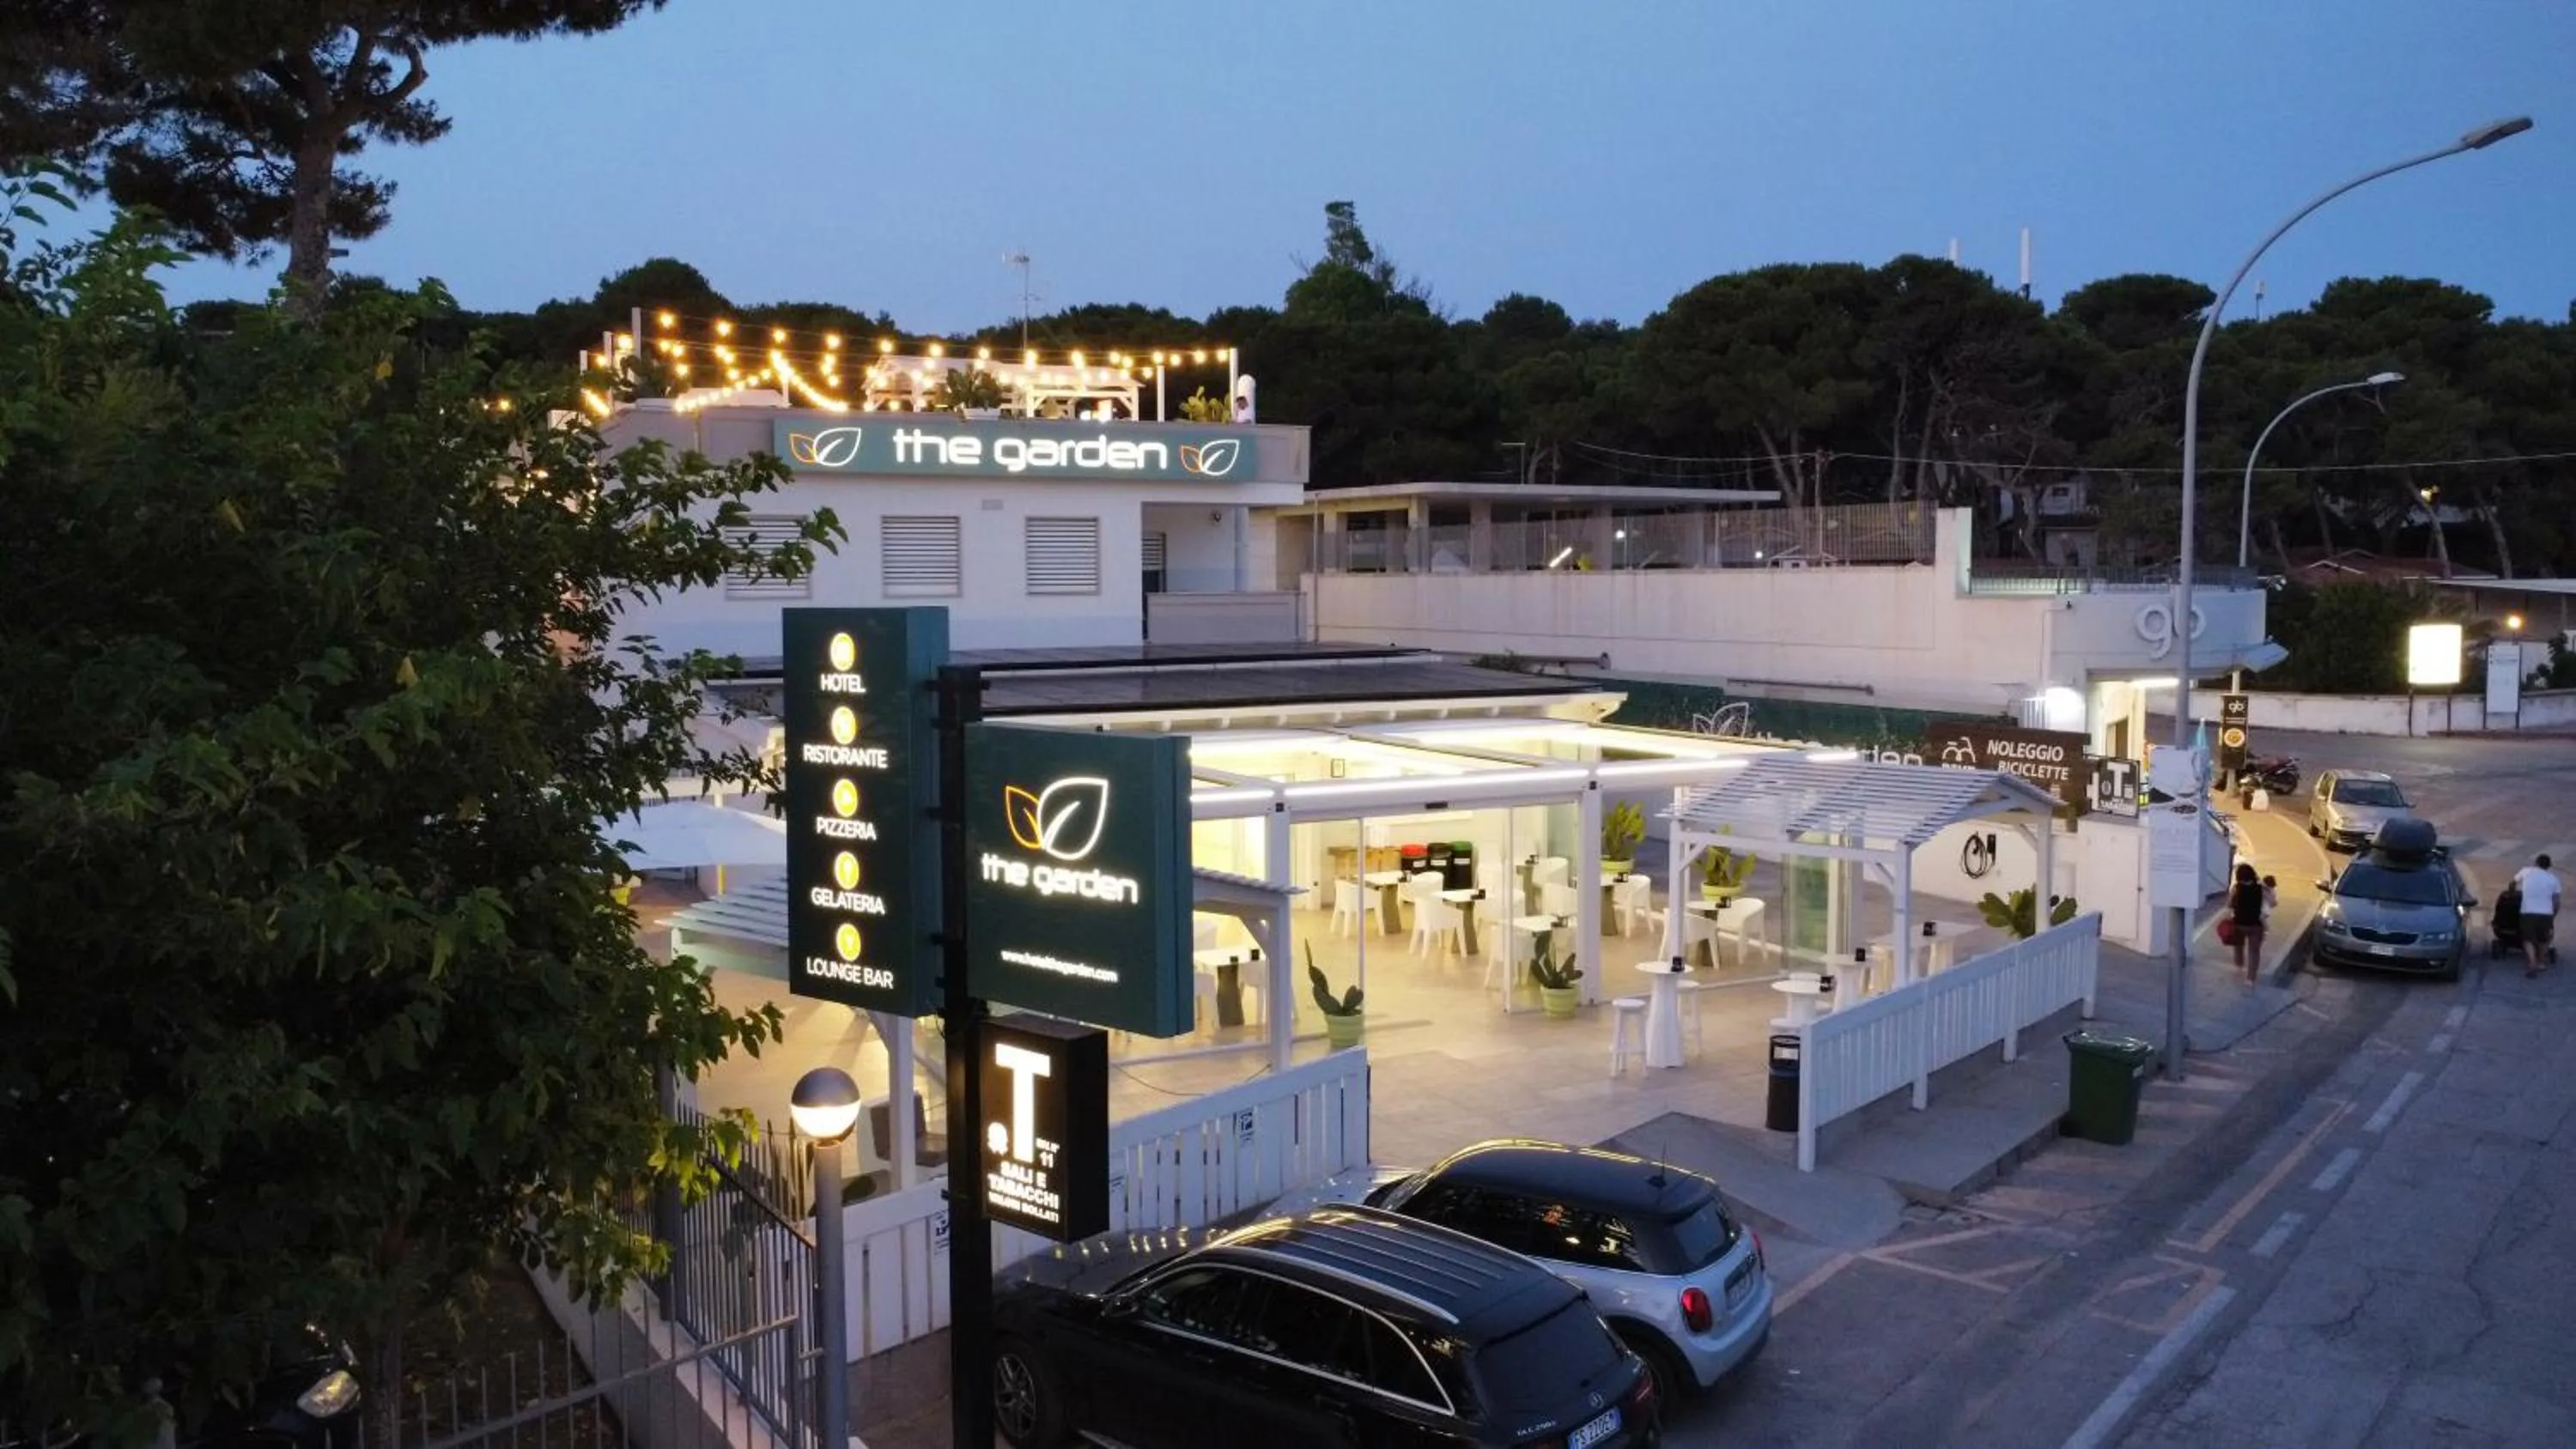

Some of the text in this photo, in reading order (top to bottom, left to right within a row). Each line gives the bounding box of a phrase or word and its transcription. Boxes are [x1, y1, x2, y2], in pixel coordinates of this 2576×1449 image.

[893, 427, 1169, 473] the garden
[820, 673, 866, 694] HOTEL
[803, 743, 888, 769] RISTORANTE
[1986, 739, 2064, 761] NOLEGGIO
[1997, 761, 2069, 780] BICICLETTE
[2106, 761, 2129, 797] T
[816, 816, 877, 840] PIZZERIA
[981, 852, 1139, 904] the garden
[811, 887, 885, 915] GELATERIA
[806, 956, 894, 989] LOUNGE BAR
[995, 1043, 1051, 1163] T
[1040, 1151, 1054, 1168] 11
[1000, 1161, 1047, 1189] SALI E
[987, 1173, 1060, 1210] TABACCHI
